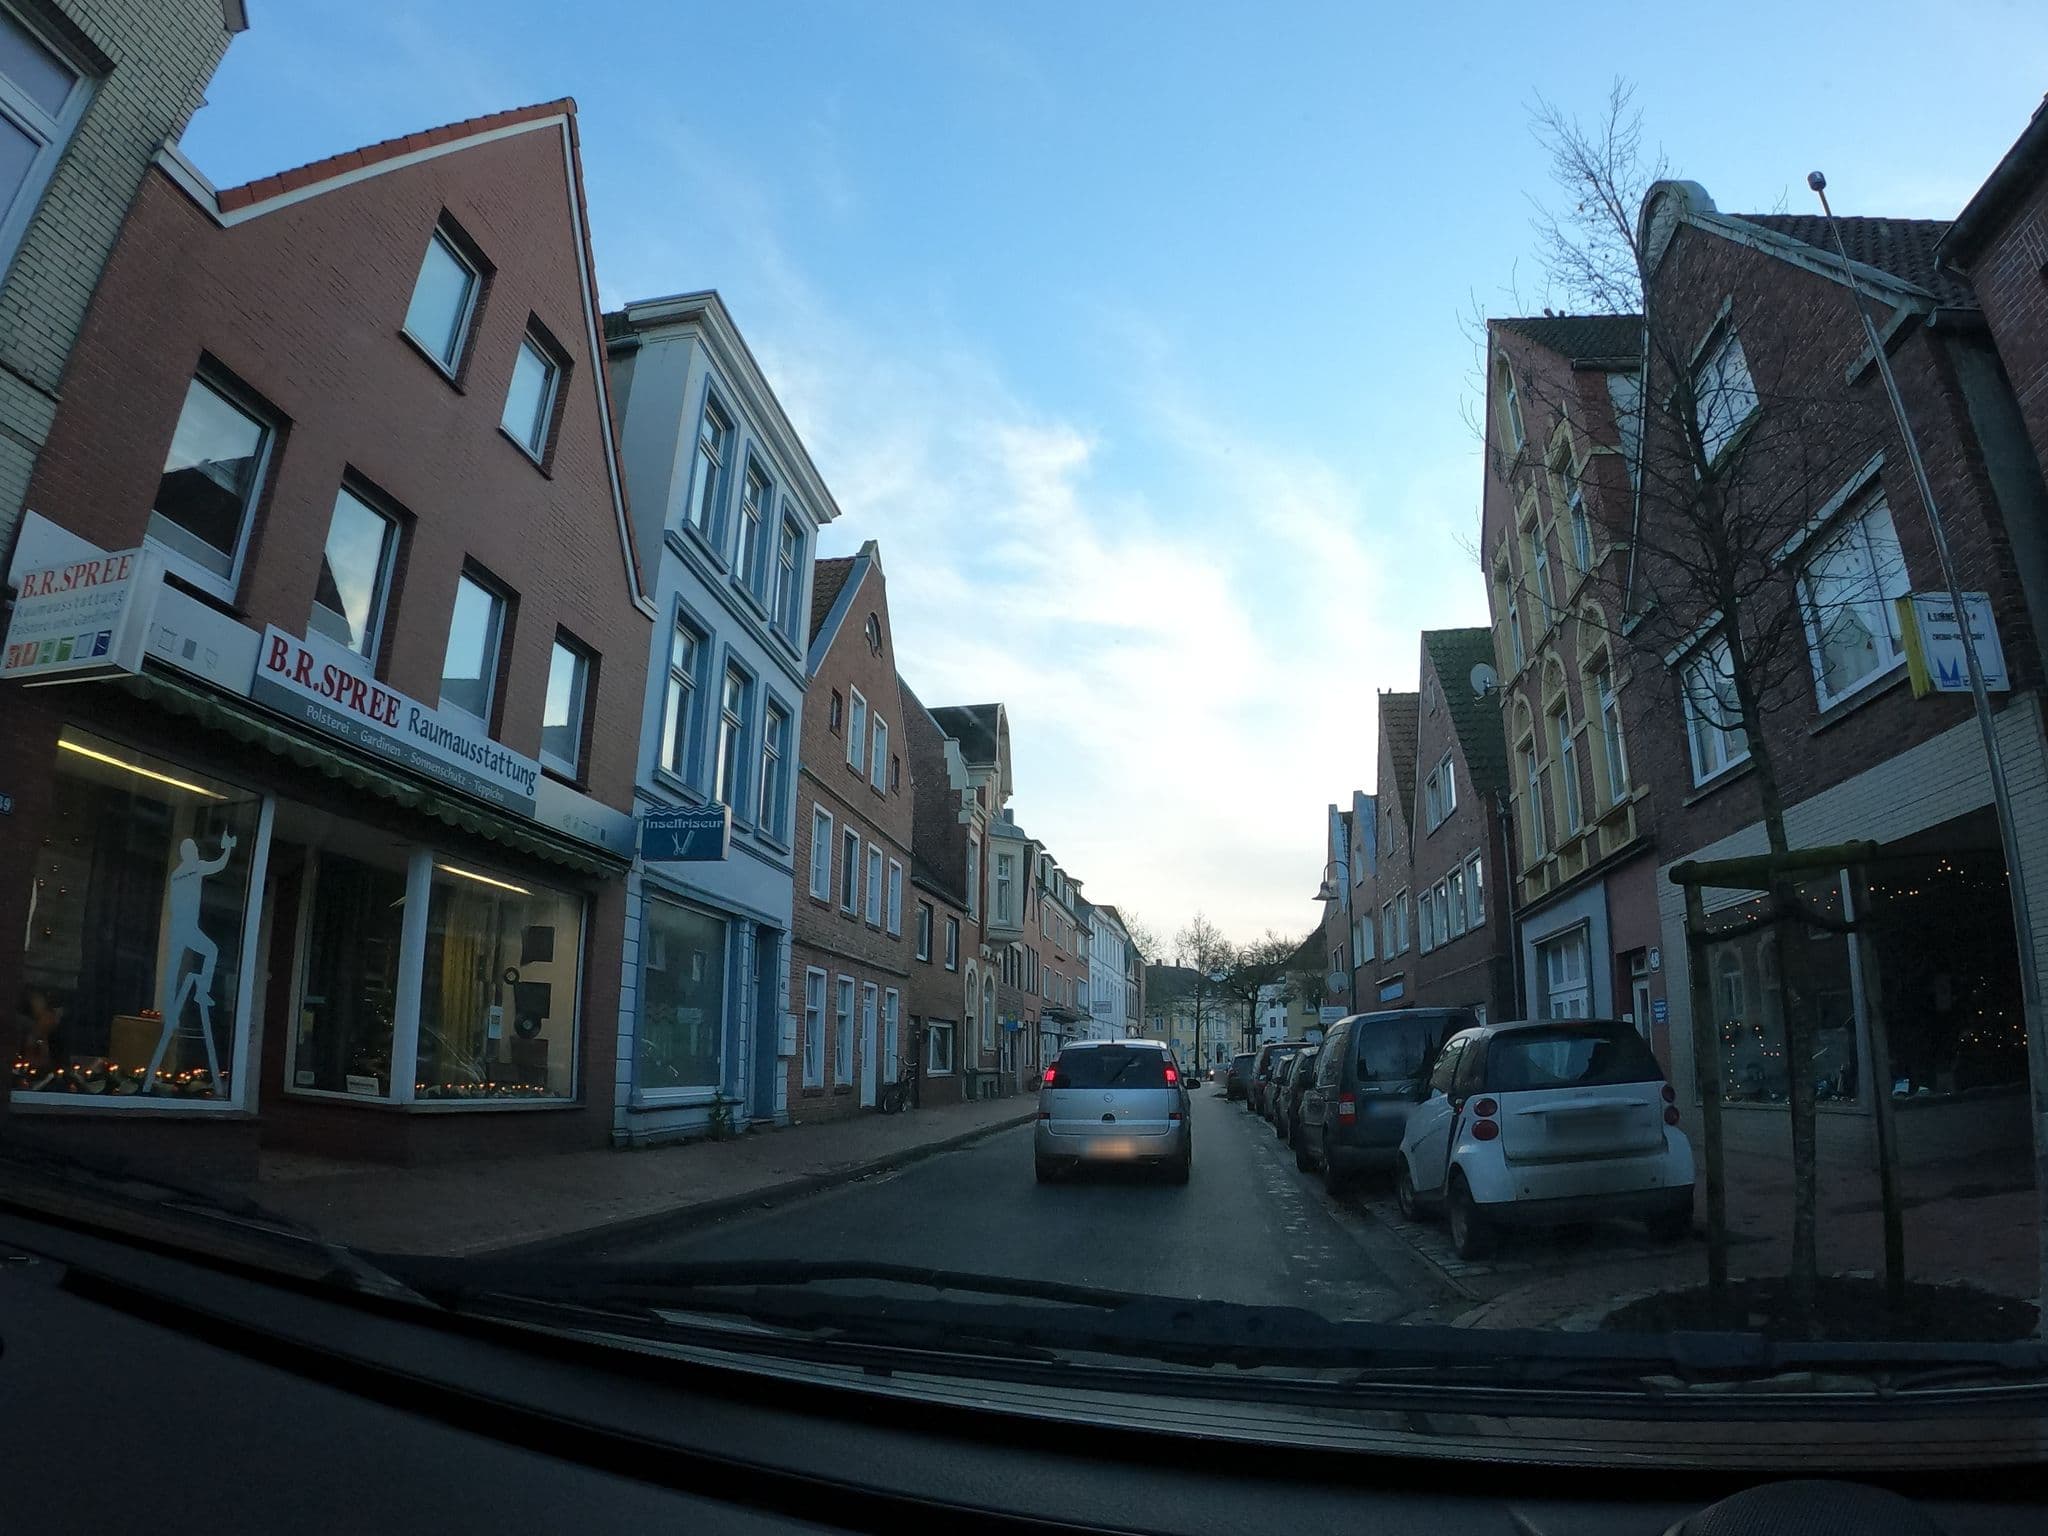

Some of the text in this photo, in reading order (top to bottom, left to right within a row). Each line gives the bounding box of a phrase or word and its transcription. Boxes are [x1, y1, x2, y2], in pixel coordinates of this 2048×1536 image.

[21, 554, 134, 599] B.R.SPREE
[266, 634, 537, 796] B.R.SPREE Raumausstattung
[306, 704, 350, 735] Polsterei
[360, 730, 401, 757] Gardinen
[410, 751, 467, 786] Sonnenschutz
[646, 818, 723, 829] Inselfriseur
